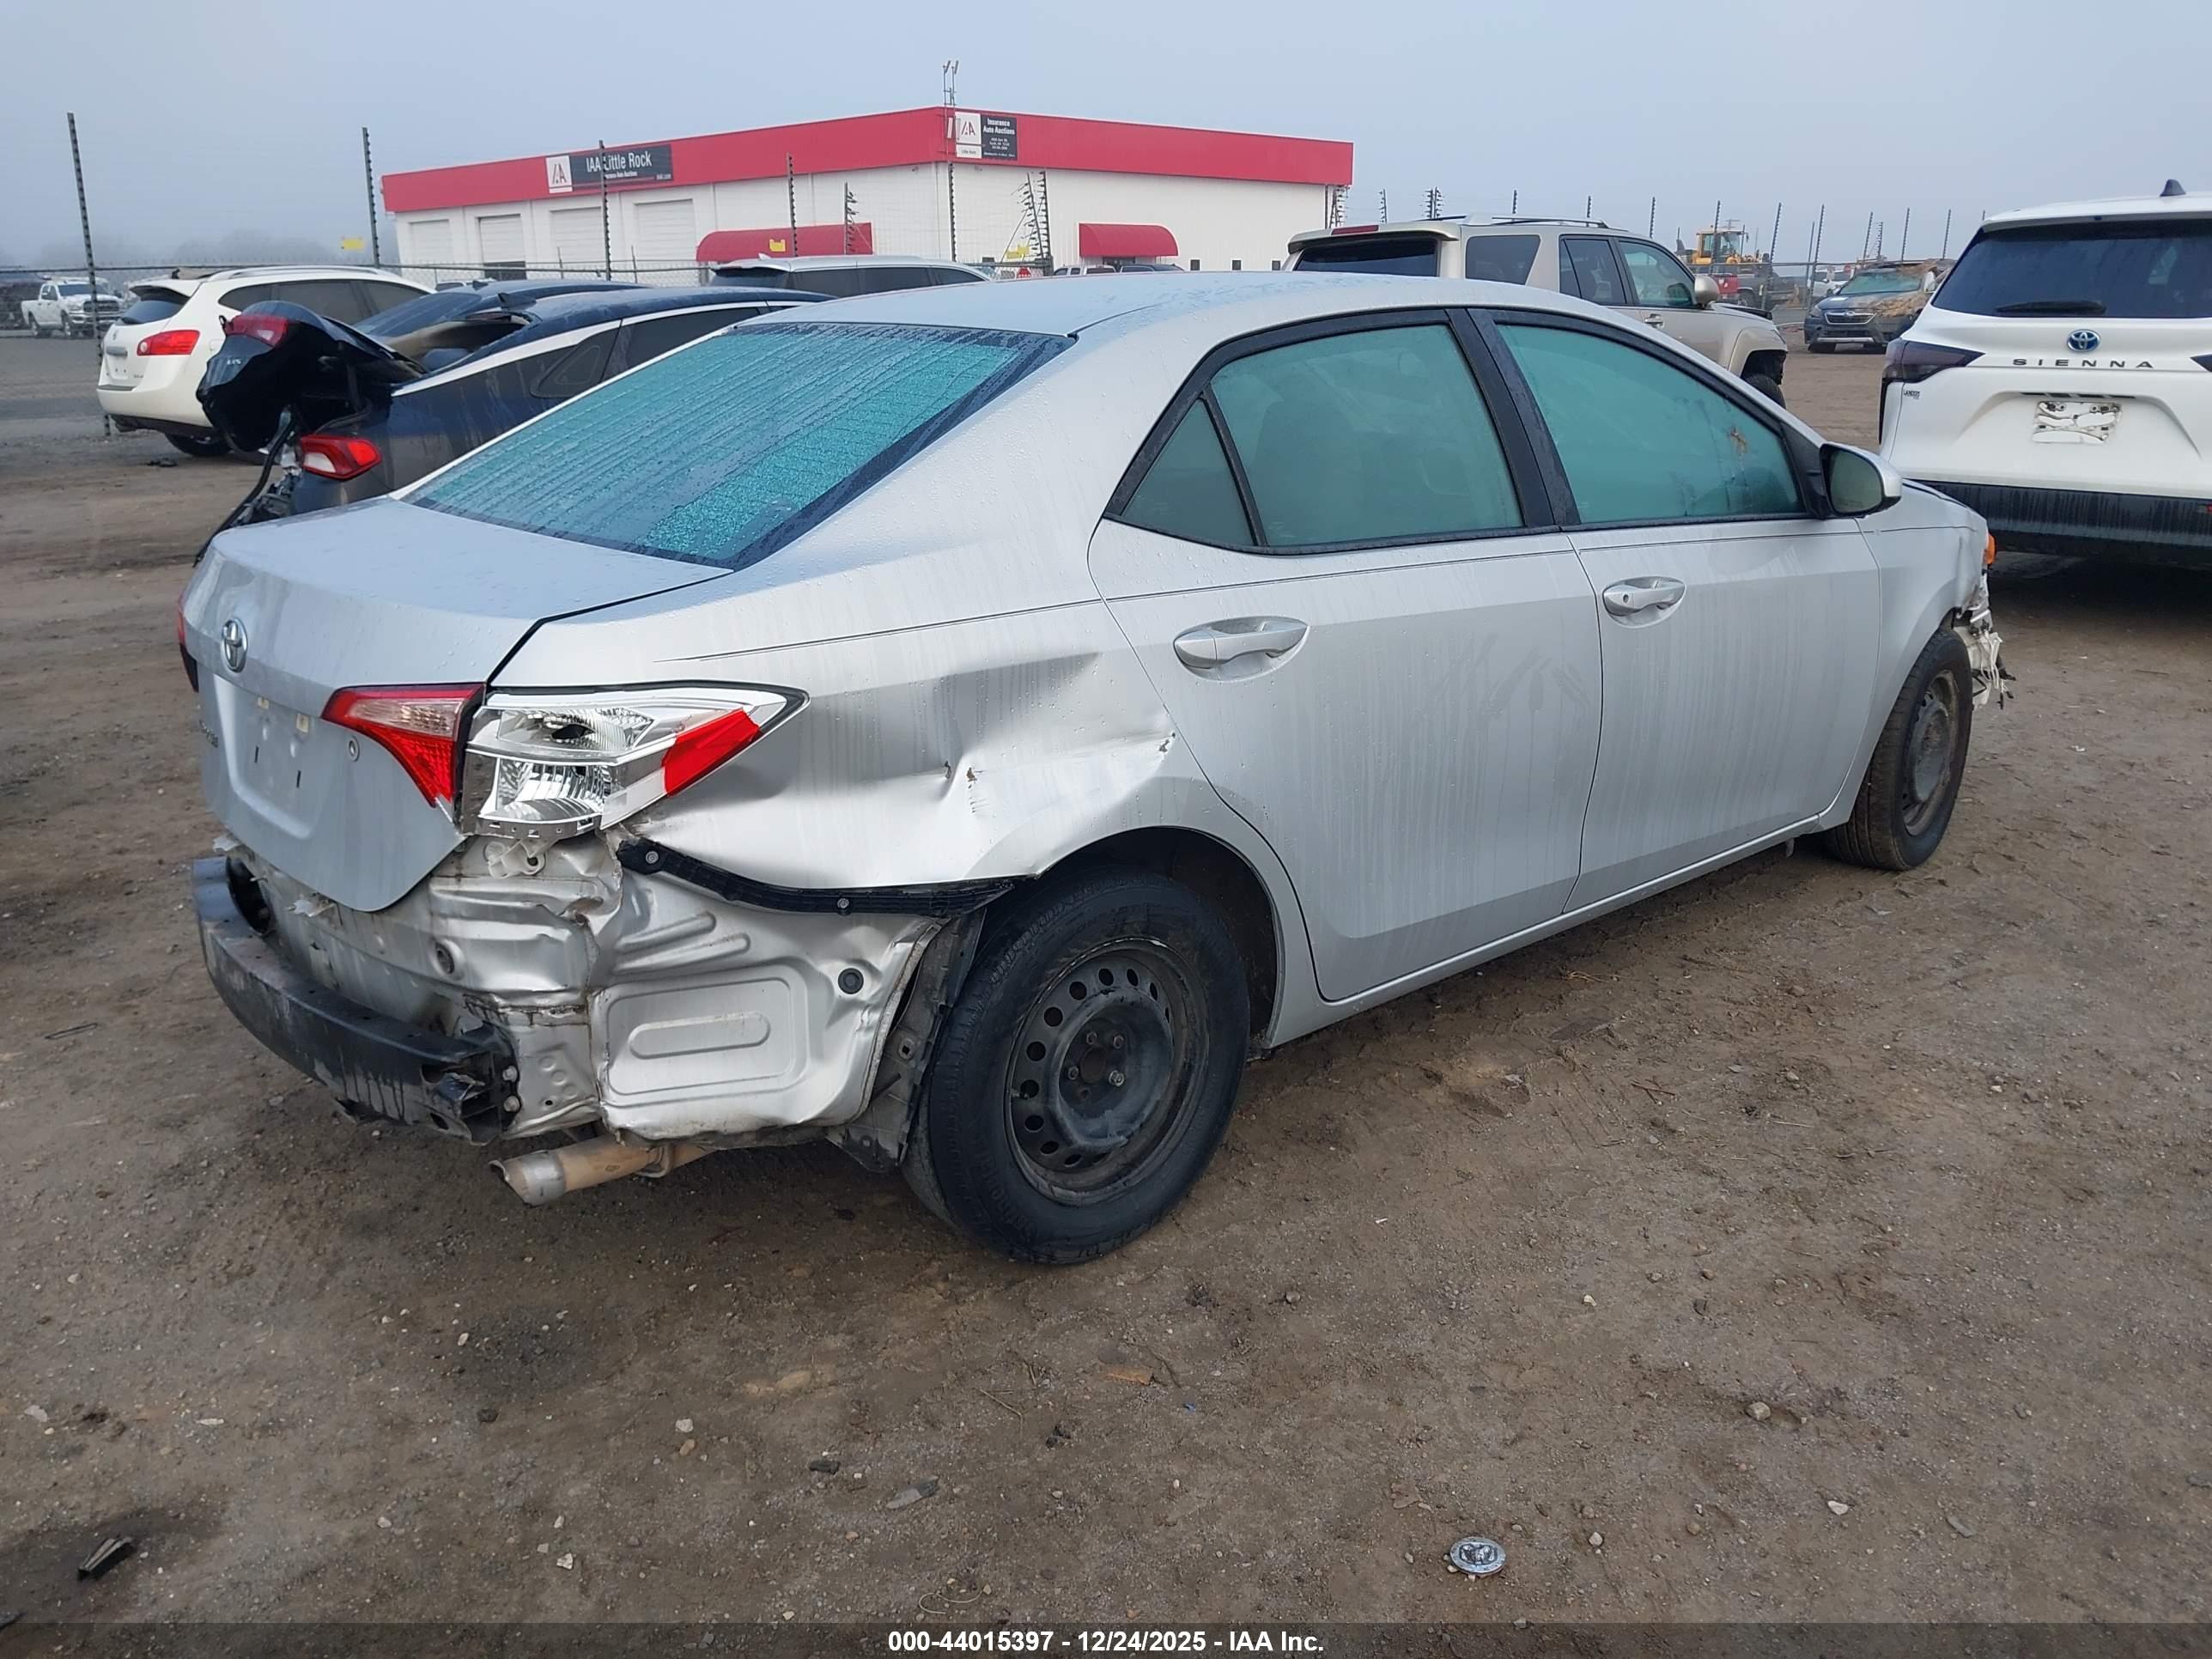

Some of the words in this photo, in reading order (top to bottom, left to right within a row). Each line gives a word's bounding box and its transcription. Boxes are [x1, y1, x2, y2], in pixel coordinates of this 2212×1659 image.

[988, 118, 1010, 126] Insurance
[995, 126, 1015, 135] Auctions
[587, 157, 602, 173] IAA
[604, 155, 626, 172] Little
[629, 151, 652, 168] Rock
[2012, 358, 2154, 368] SIENNA
